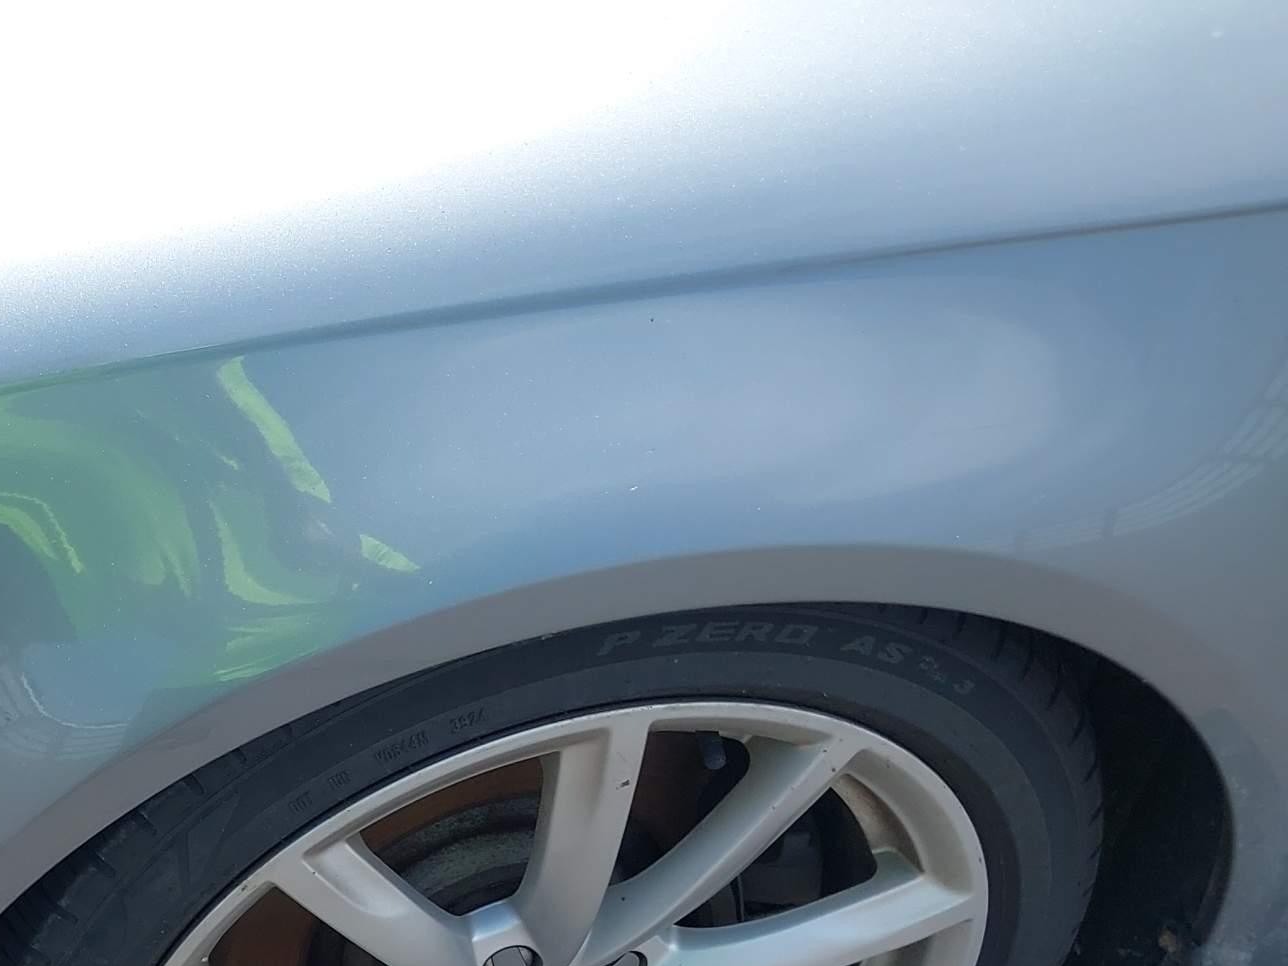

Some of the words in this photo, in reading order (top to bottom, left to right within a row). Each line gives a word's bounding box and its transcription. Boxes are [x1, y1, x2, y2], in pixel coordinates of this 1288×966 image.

[596, 630, 641, 657] P
[651, 621, 820, 647] ZERO
[840, 635, 913, 665] AS
